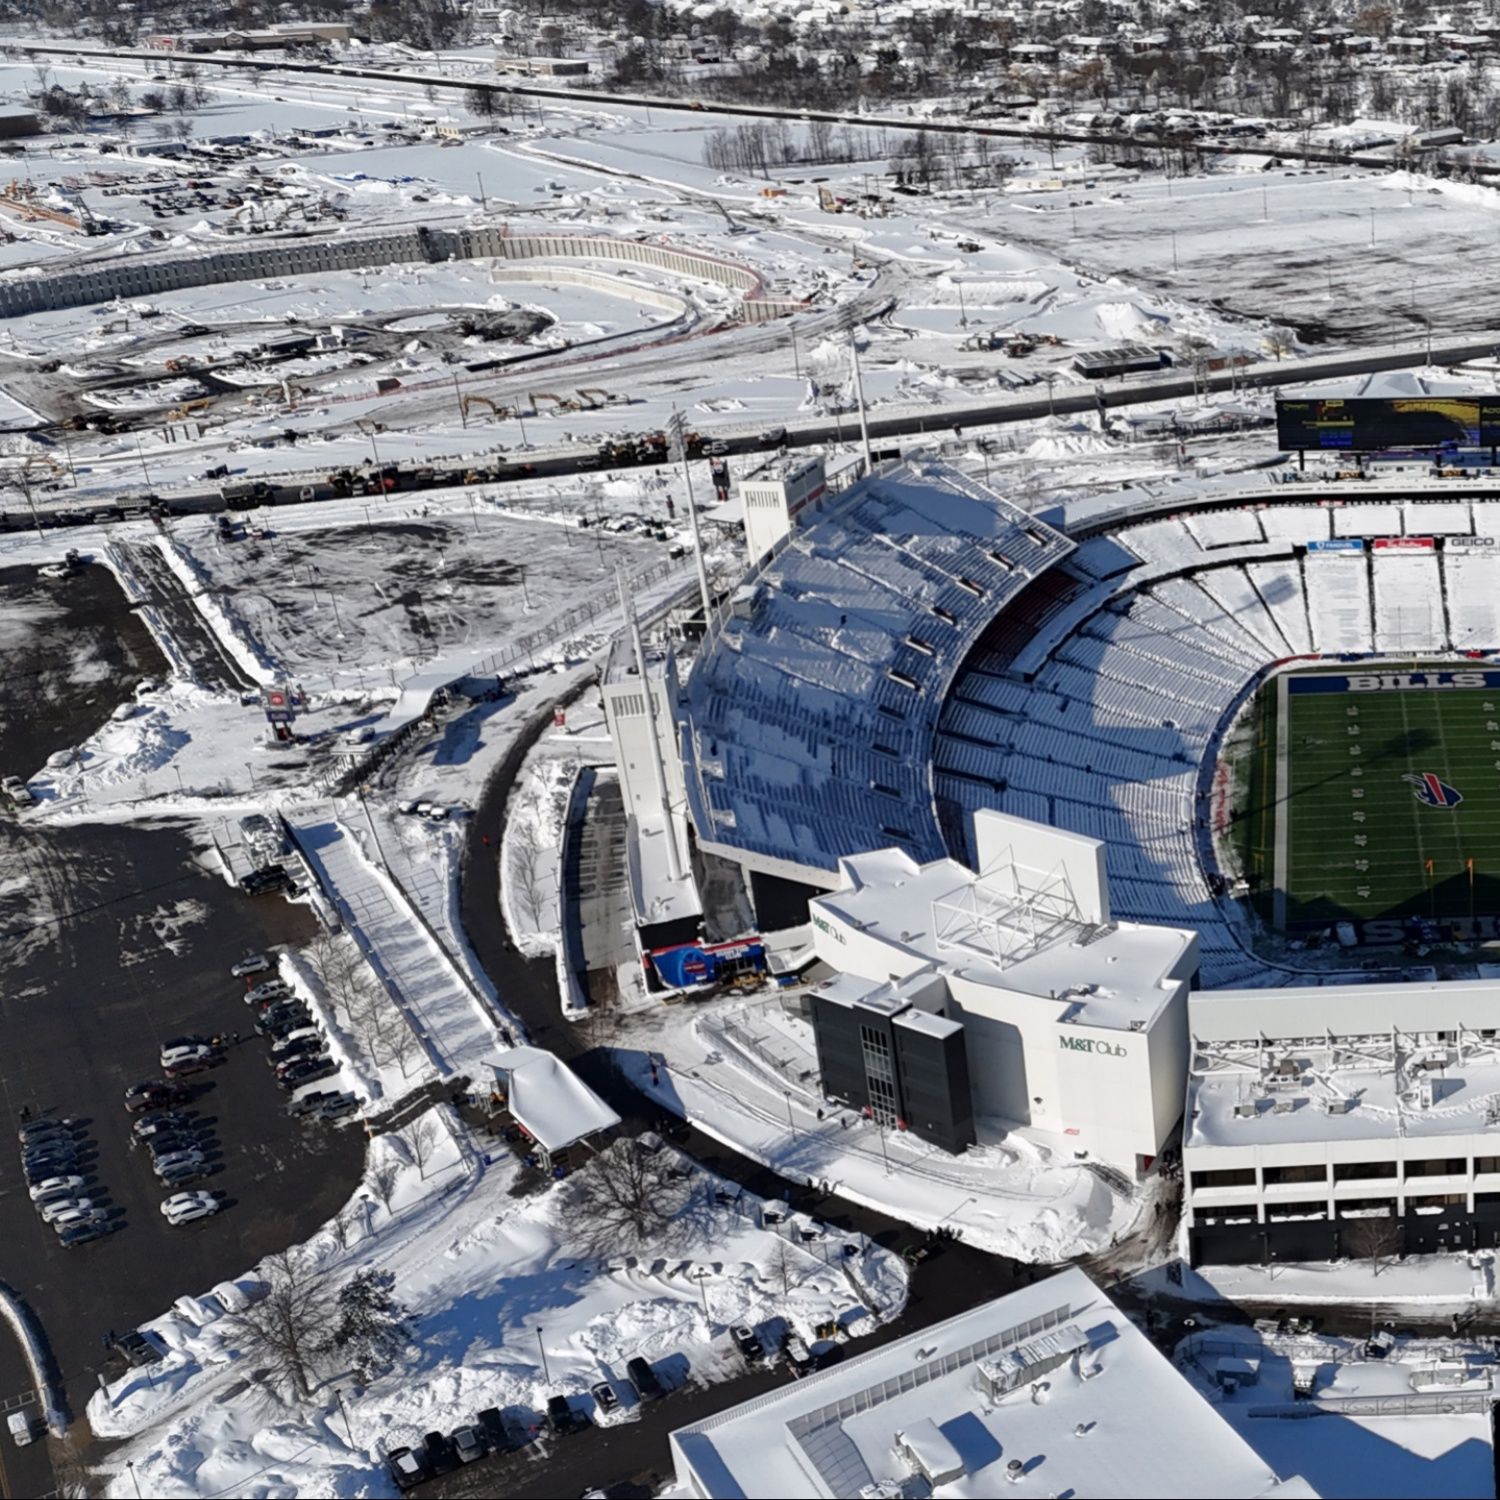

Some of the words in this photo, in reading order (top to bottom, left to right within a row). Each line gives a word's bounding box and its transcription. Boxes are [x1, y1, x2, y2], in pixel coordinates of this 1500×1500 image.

[1451, 537, 1494, 547] GEICO
[1347, 673, 1487, 691] BILLS
[1059, 1035, 1095, 1053] M&T
[1096, 1040, 1128, 1058] Club
